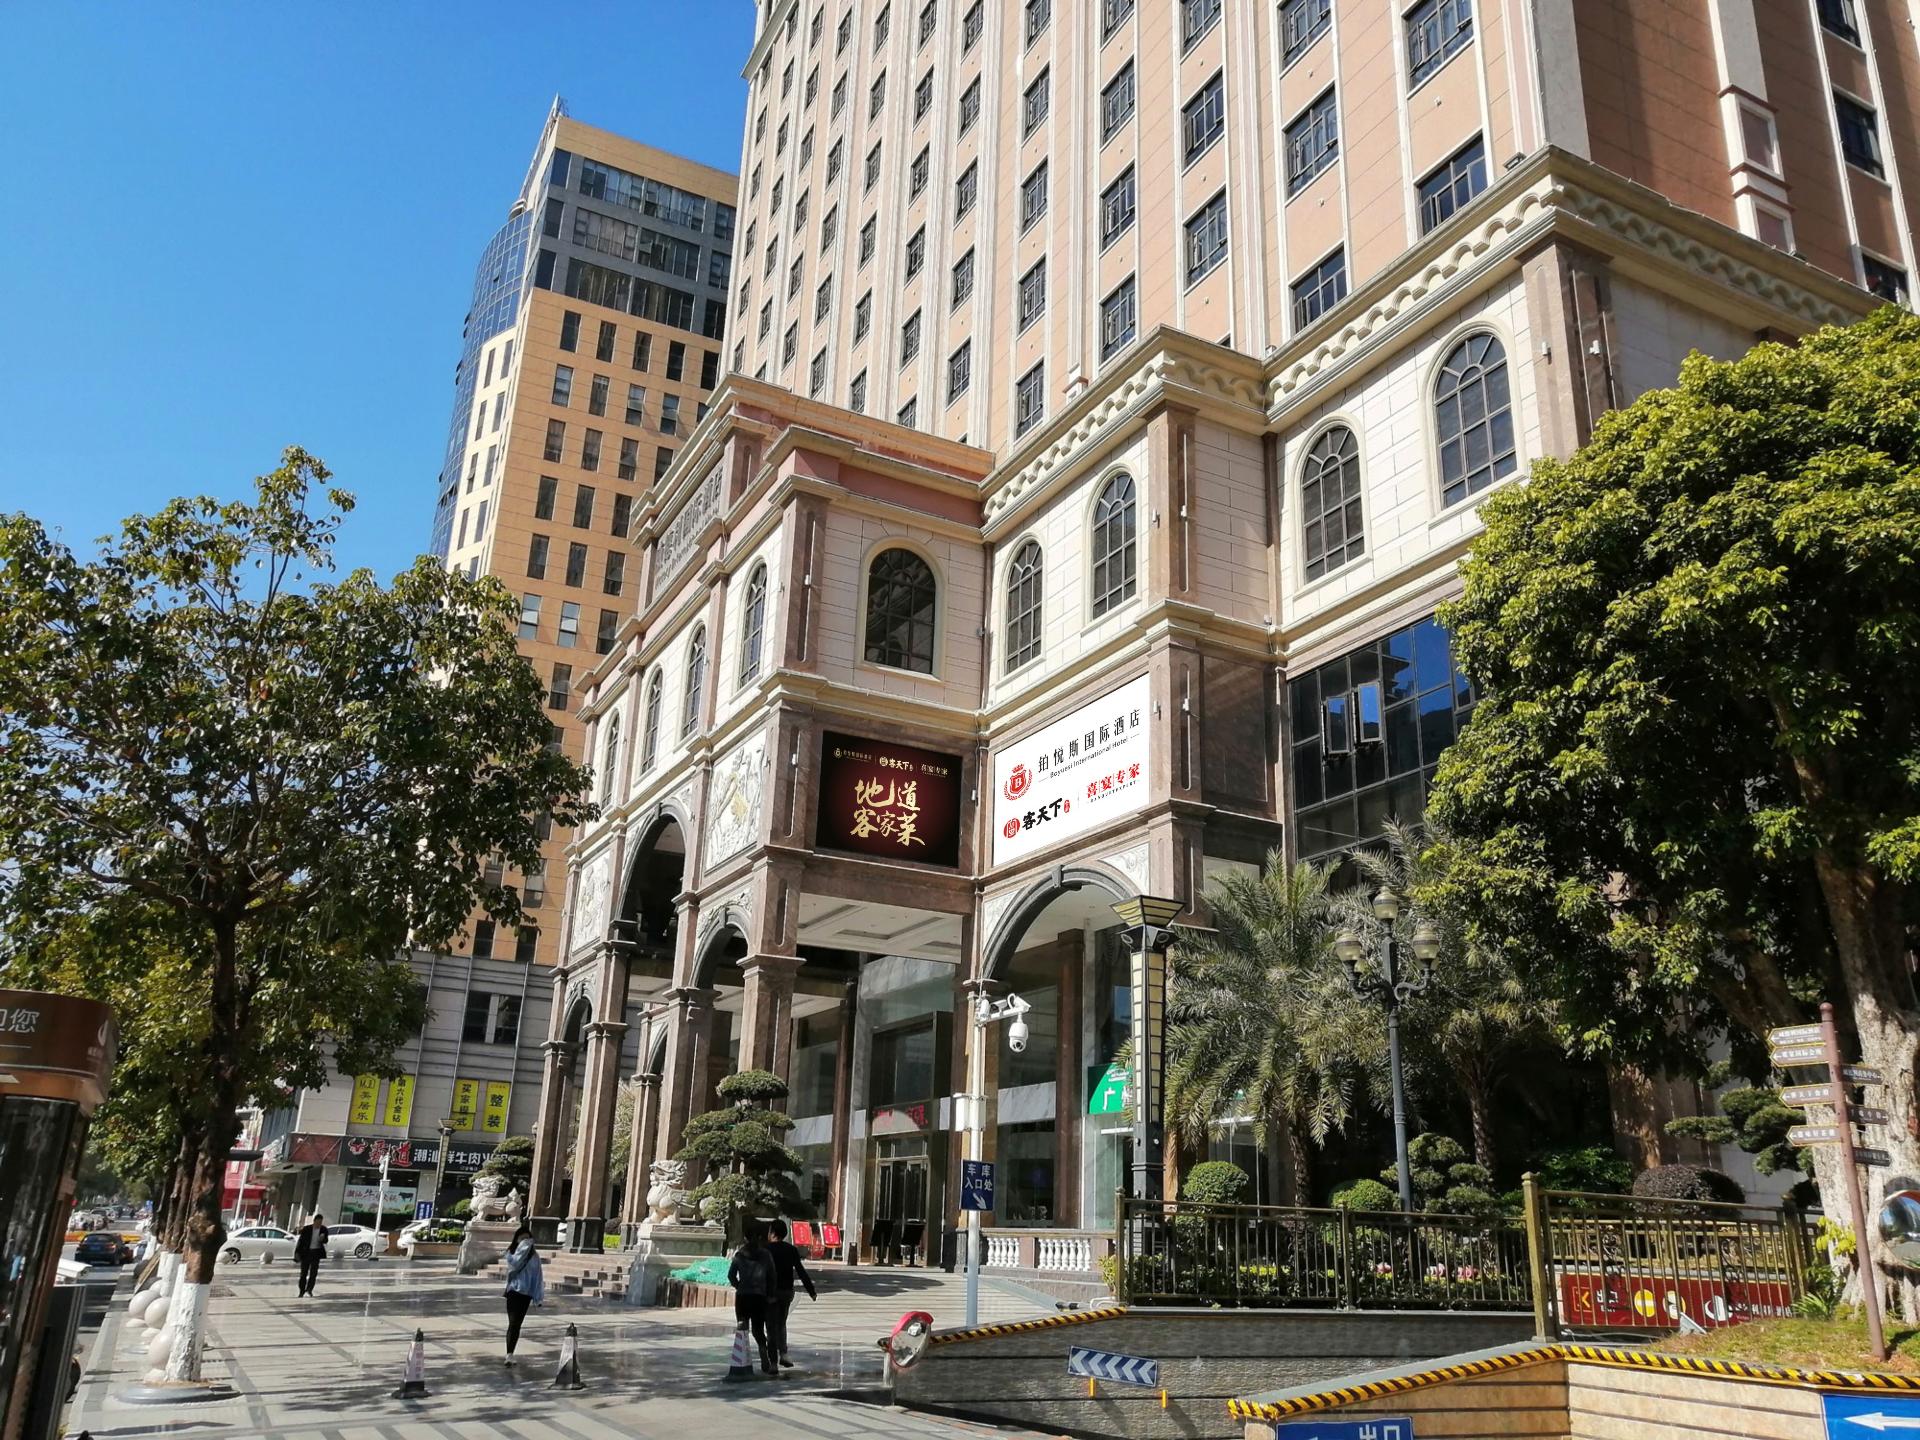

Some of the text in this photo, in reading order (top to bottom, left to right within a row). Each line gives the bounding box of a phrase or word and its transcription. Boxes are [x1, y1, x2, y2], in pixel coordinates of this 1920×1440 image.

[1038, 709, 1140, 773] 铂悦斯国际酒店
[1073, 744, 1111, 767] International
[1112, 738, 1128, 750] Hotel
[854, 776, 921, 811] 地道
[850, 806, 925, 847] 客家菜
[1022, 798, 1063, 831] 客天下
[487, 1093, 504, 1128] 整装
[964, 1178, 993, 1192] 入口处
[967, 1163, 991, 1177] 车库
